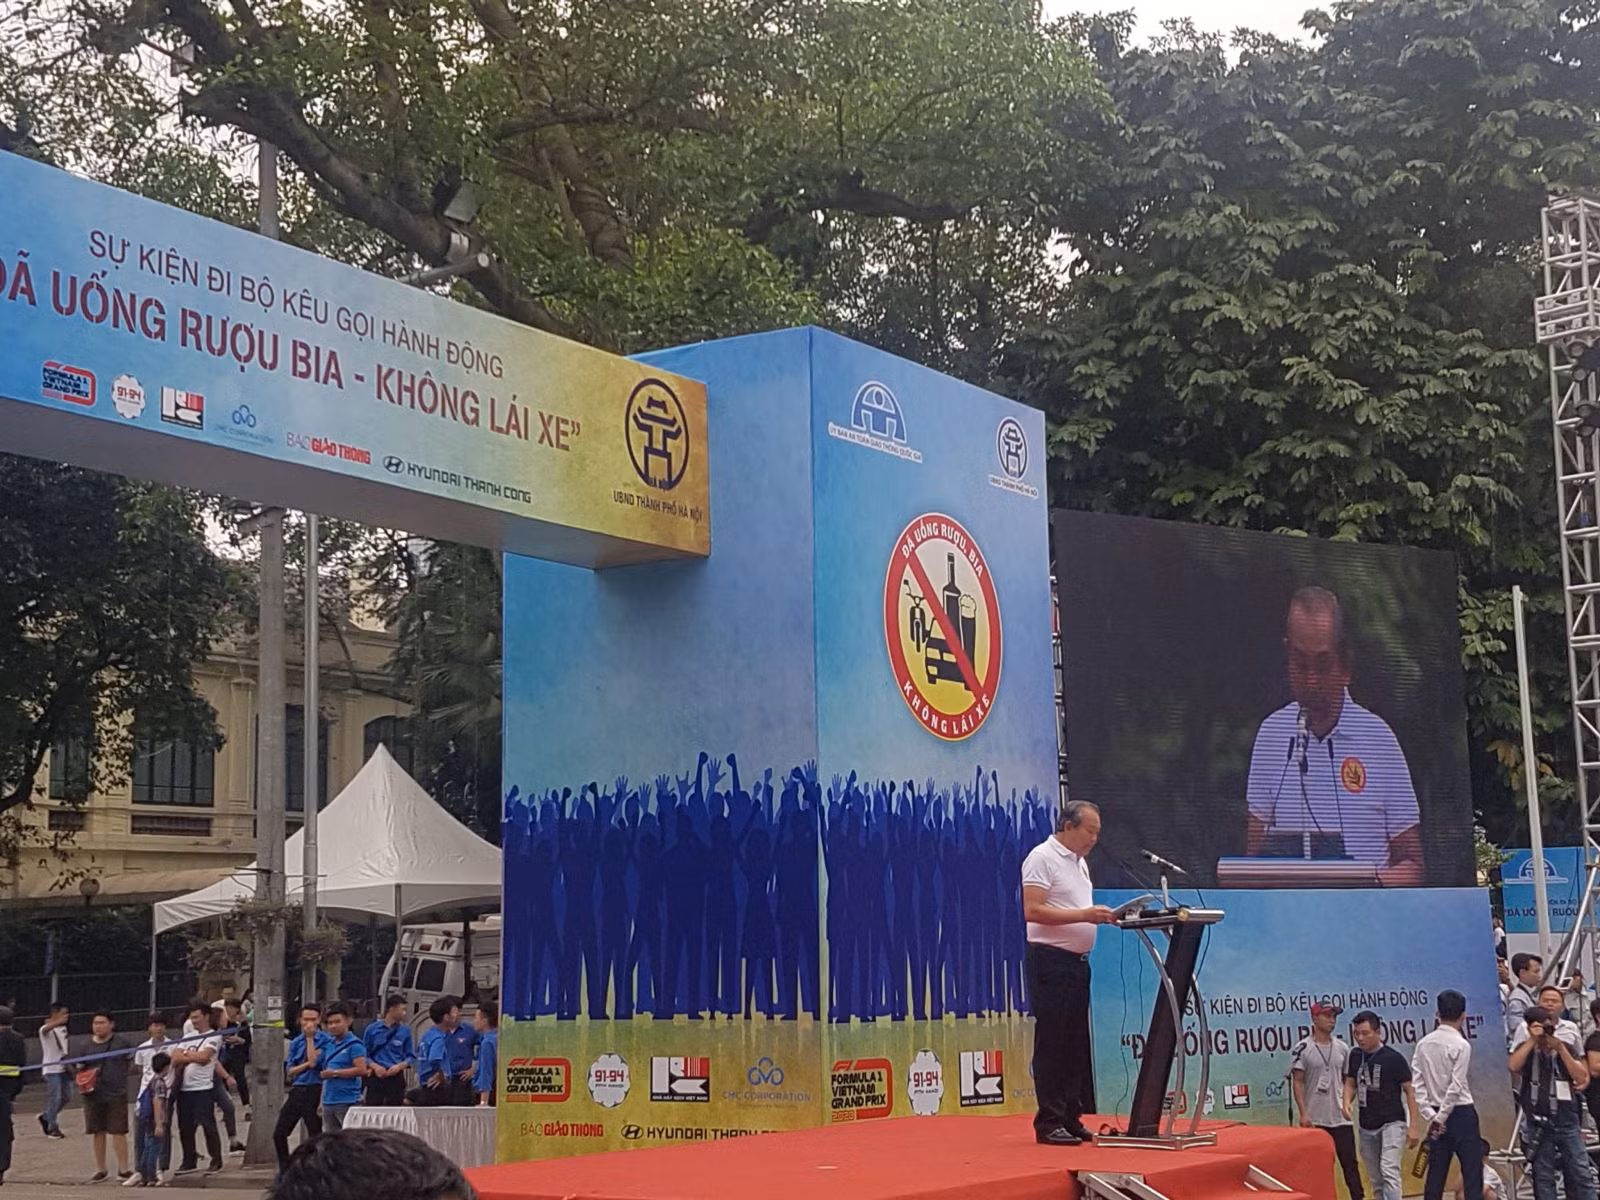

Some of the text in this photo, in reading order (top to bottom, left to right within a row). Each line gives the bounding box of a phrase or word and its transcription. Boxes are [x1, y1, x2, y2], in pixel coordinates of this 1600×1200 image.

[89, 230, 503, 380] SỰ KIỆN ĐI BỘ KÊU GỌI HÀNH ĐỘNG
[51, 269, 166, 342] UỐNG
[180, 307, 279, 373] RƯỢU
[291, 339, 344, 389] BIA
[376, 364, 480, 427] KHÔNG
[489, 394, 530, 441] LÁI
[538, 411, 581, 451] XE”
[117, 386, 140, 400] 91-94
[407, 462, 531, 503] HYUNDAI THANH CONG
[613, 490, 635, 506] UBND
[636, 495, 660, 512] THÀNH
[968, 549, 983, 577] BIA
[903, 680, 990, 735] KHÔNG LÁI XE
[1210, 994, 1243, 1018] KIỆN
[1248, 997, 1262, 1014] ĐI
[1265, 992, 1286, 1013] BỘ
[1349, 988, 1386, 1009] HÀNH
[1389, 986, 1428, 1010] ĐỘNG
[1235, 1024, 1292, 1058] RƯỢU
[506, 1067, 561, 1076] FORMULA 1
[595, 1070, 624, 1082] 91-94
[832, 1071, 883, 1085] FORMULA 1
[913, 1070, 938, 1087] 91-94
[507, 1076, 553, 1085] VIETNAM
[506, 1084, 564, 1093] GRAND PRIX
[832, 1083, 876, 1097] VIETNAM
[744, 1091, 811, 1102] CORPORATION
[831, 1094, 886, 1109] GRAND PRIX
[646, 1126, 708, 1140] HYUNDAI
